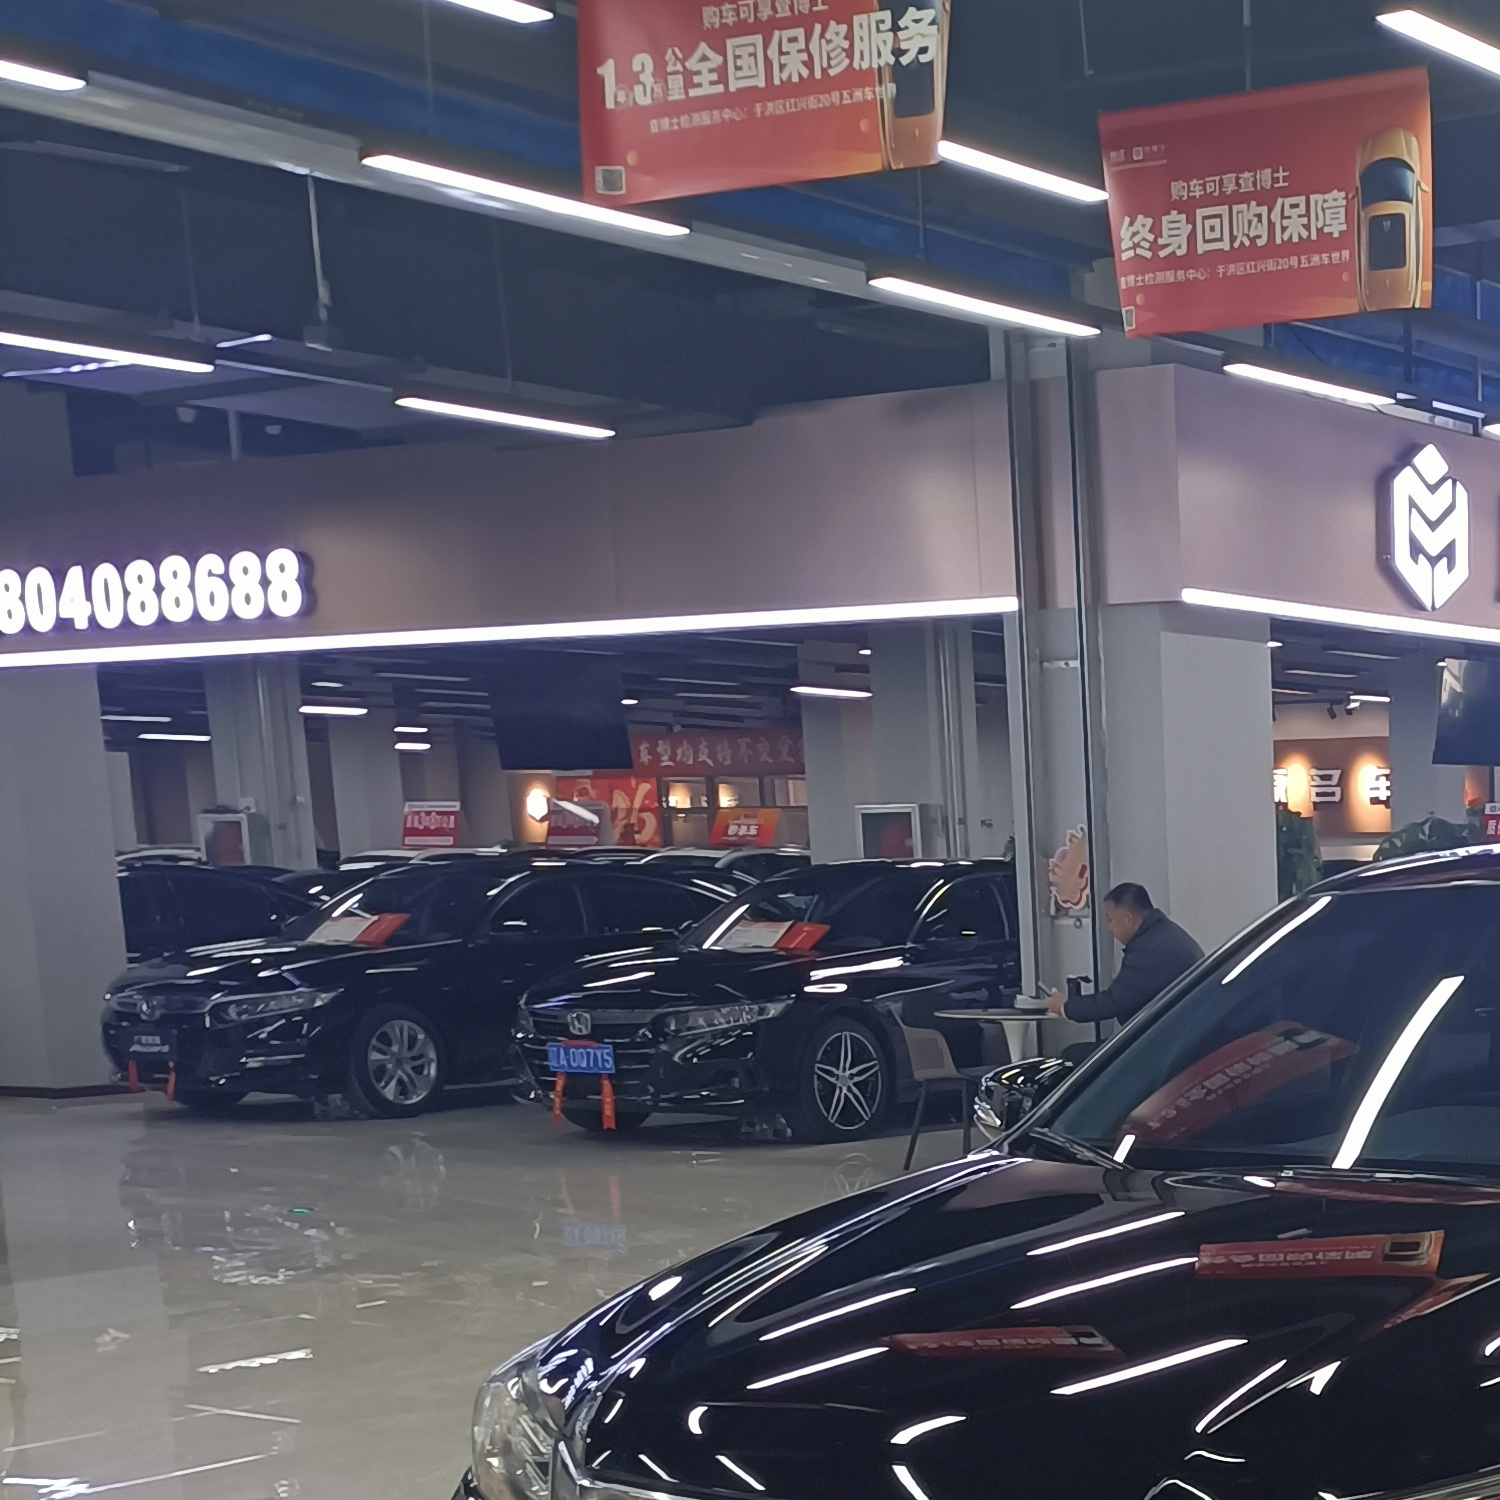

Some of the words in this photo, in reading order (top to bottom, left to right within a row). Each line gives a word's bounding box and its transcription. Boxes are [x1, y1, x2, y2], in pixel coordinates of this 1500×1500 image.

[1170, 166, 1290, 201] 购车可享查博士
[1120, 189, 1348, 261] 终身回购保障
